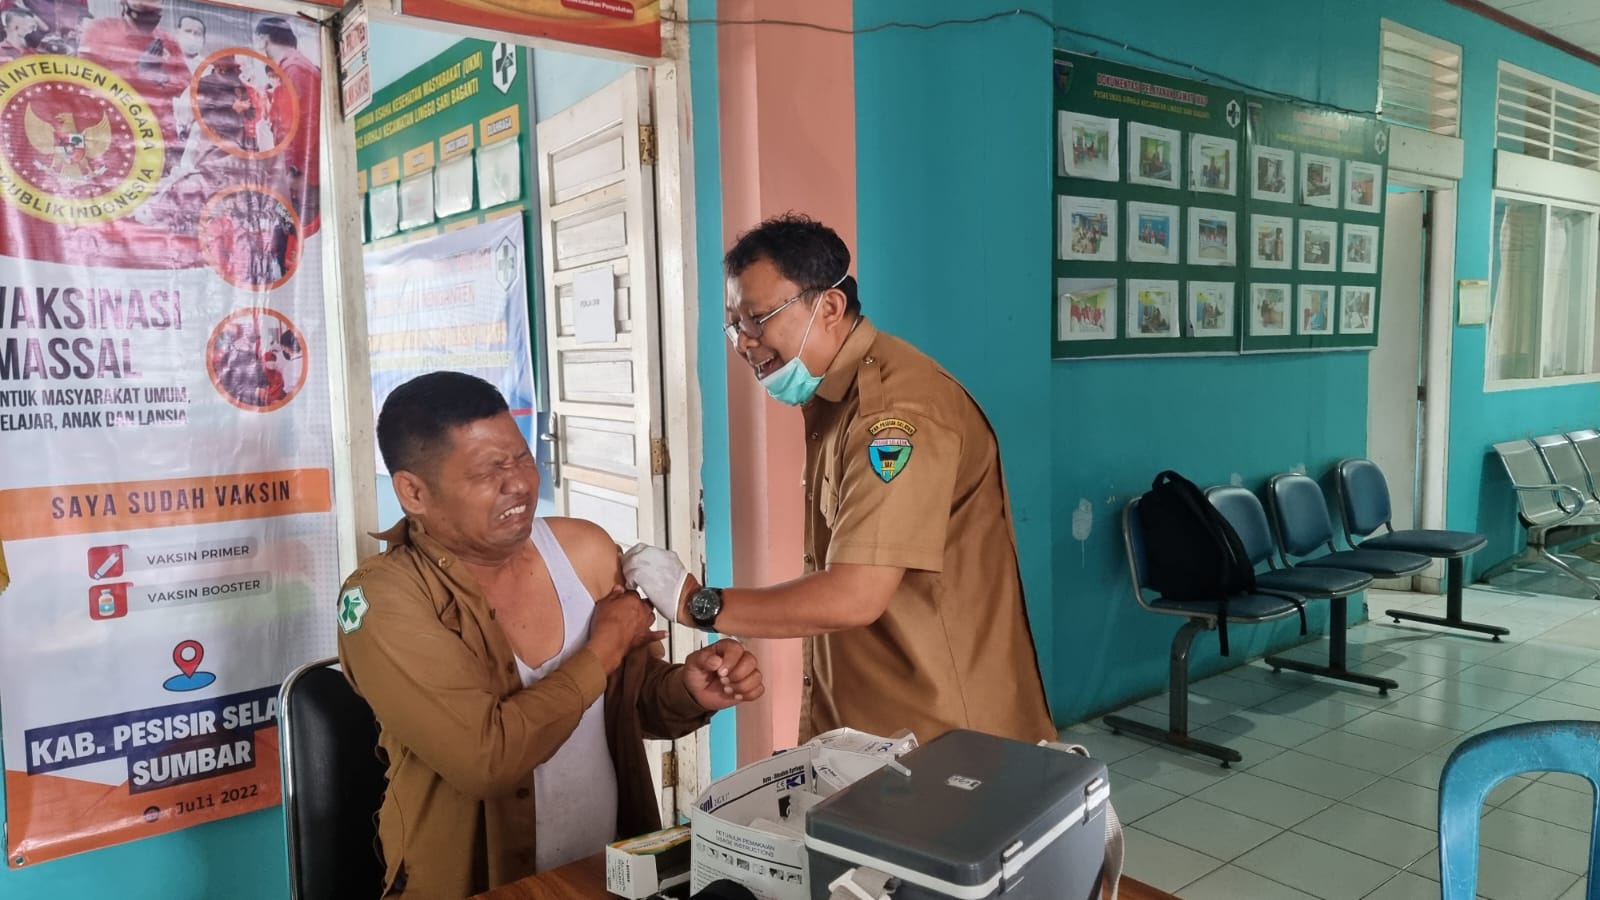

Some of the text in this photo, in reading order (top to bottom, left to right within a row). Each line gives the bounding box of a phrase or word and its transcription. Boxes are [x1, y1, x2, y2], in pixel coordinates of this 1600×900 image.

[8, 61, 155, 151] INTELIJEN NEGARA
[70, 168, 154, 219] INDONESIA
[0, 337, 143, 380] MASSAL
[0, 386, 191, 407] NTUK MASYARAKAT UMUM,
[0, 409, 187, 432] ELAJAR, ANAK DAN LANSIA
[52, 480, 290, 519] SAYA SUDAH VAKSIN
[146, 545, 250, 565] VAKSIN PRIMER
[147, 580, 261, 603] VAKSIN BOOSTER
[31, 697, 279, 767] KAB. PESISIR SELA
[133, 740, 252, 786] SUMBAR
[176, 784, 258, 815] Juli 2022
